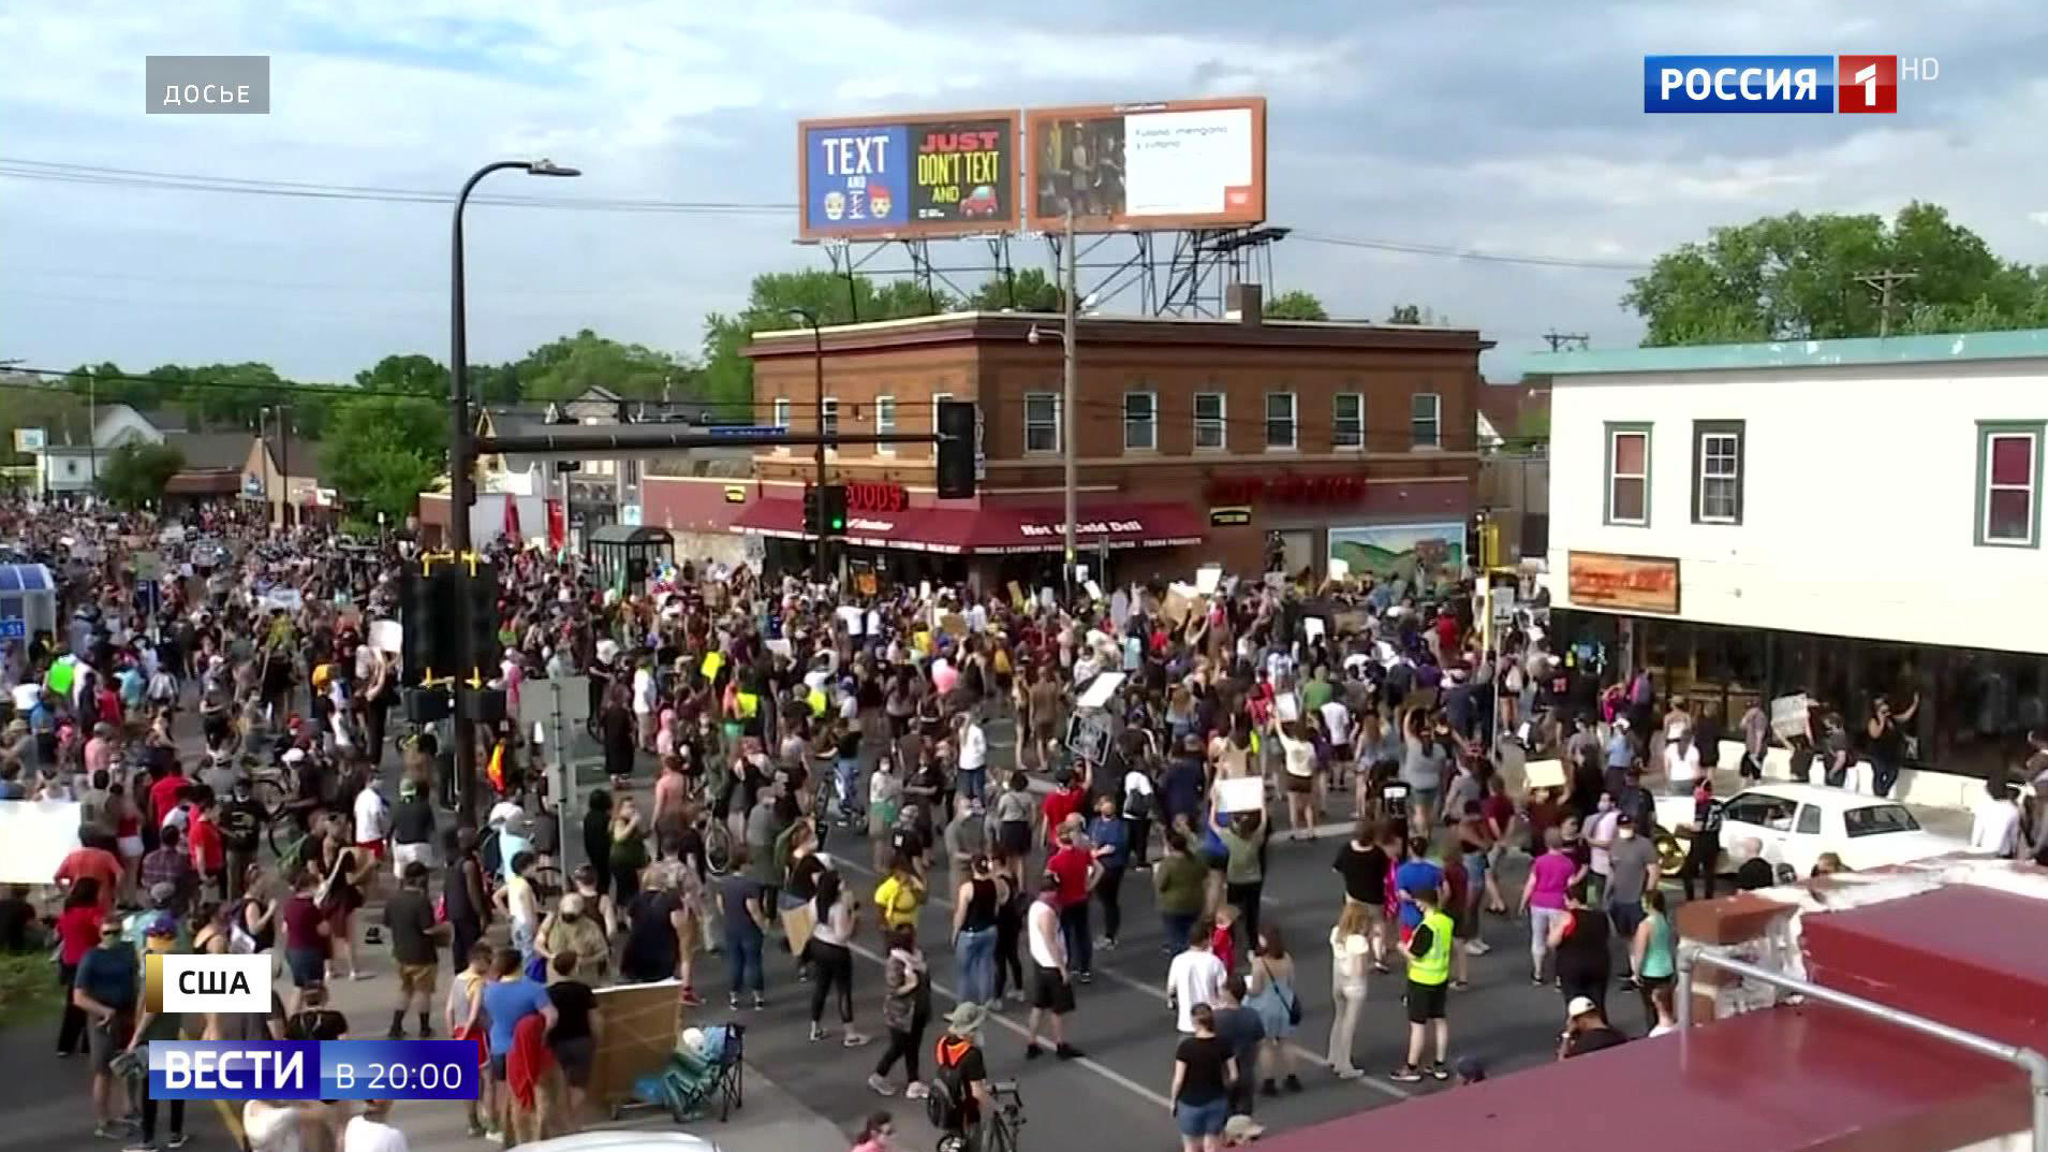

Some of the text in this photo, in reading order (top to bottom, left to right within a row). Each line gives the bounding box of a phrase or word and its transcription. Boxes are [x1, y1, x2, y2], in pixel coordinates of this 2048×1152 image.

[919, 131, 999, 152] JUST
[822, 136, 889, 175] TEXT
[918, 151, 999, 185] DON'T TEXT
[847, 176, 867, 189] AND
[932, 186, 960, 203] AND
[847, 484, 901, 512] OODS
[1021, 524, 1052, 536] Hot
[1109, 520, 1143, 532] Deli
